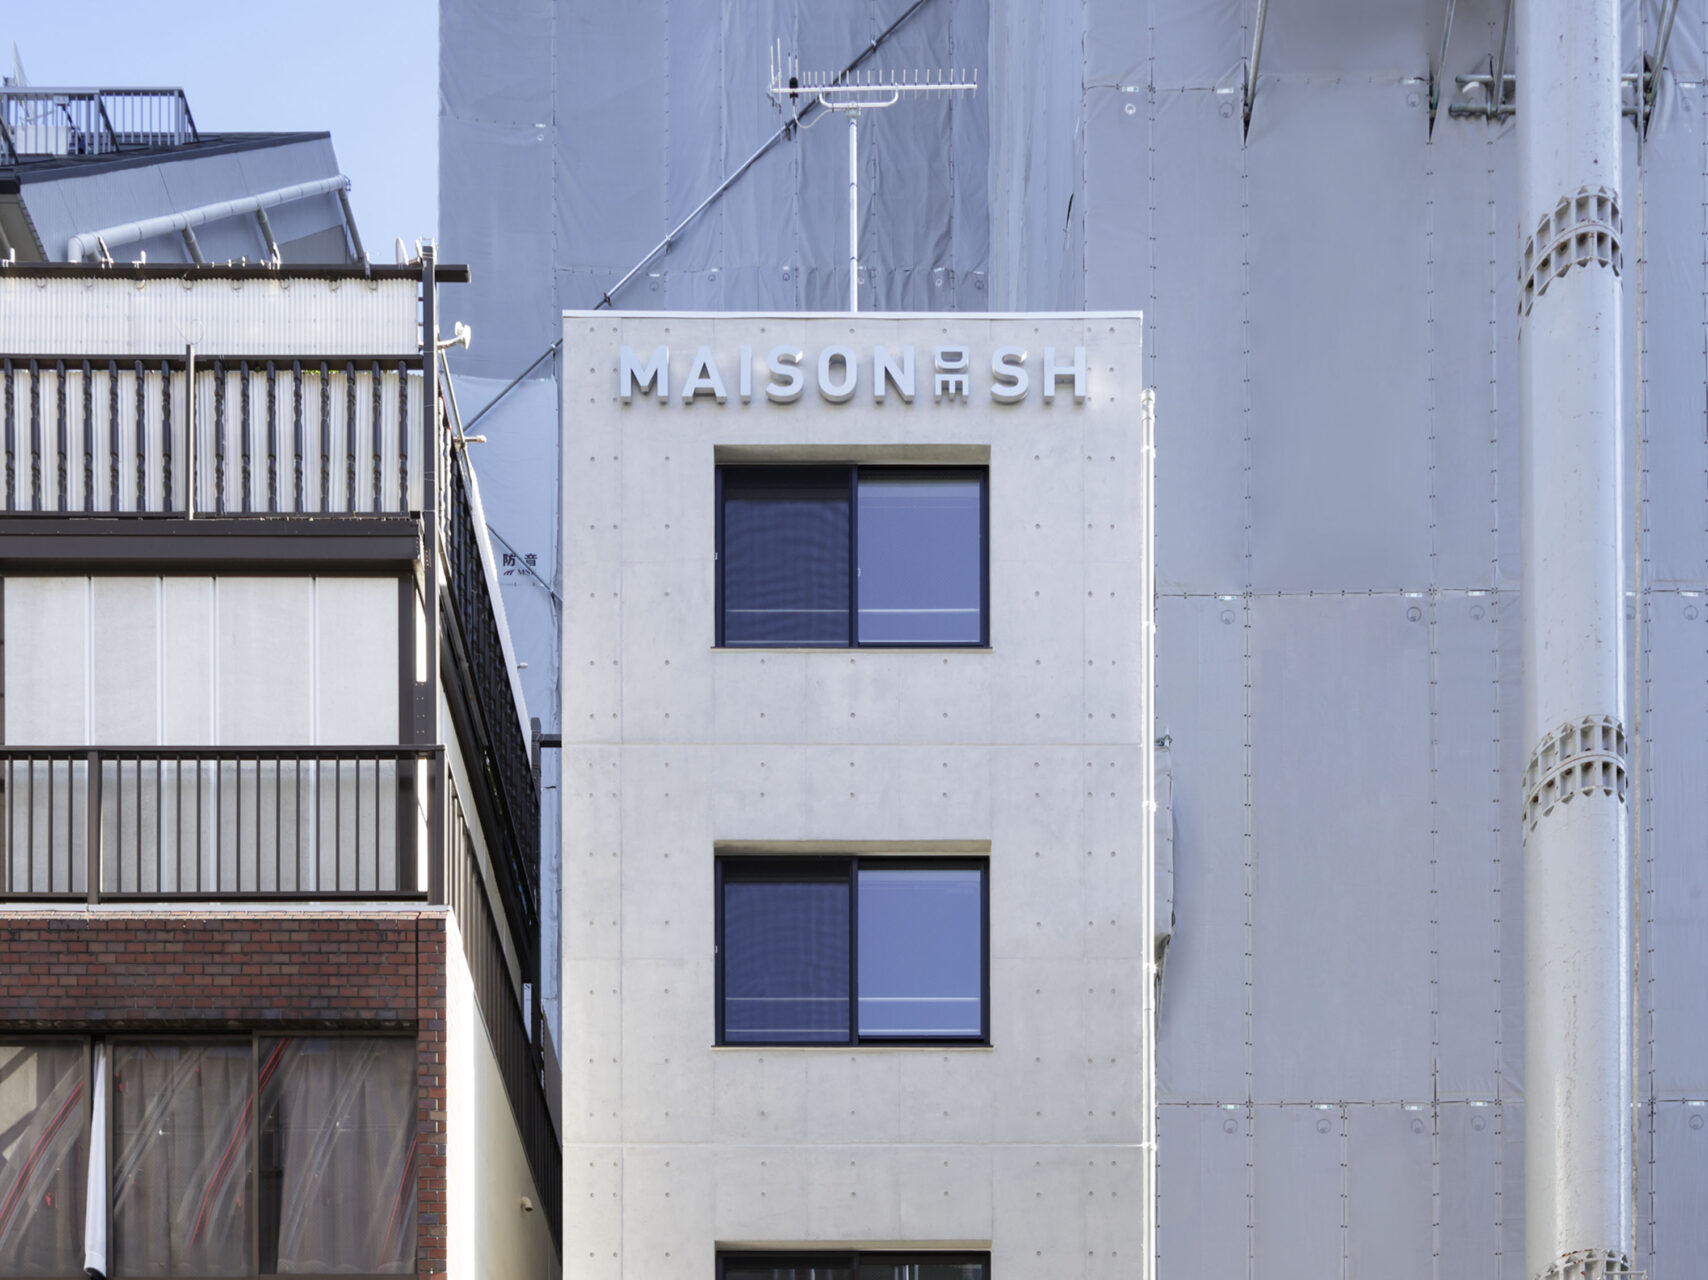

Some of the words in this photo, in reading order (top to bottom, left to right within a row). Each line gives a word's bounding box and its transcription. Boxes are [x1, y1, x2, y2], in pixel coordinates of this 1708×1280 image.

[619, 344, 916, 403] MAISON
[935, 345, 969, 401] DE
[990, 345, 1086, 404] SH
